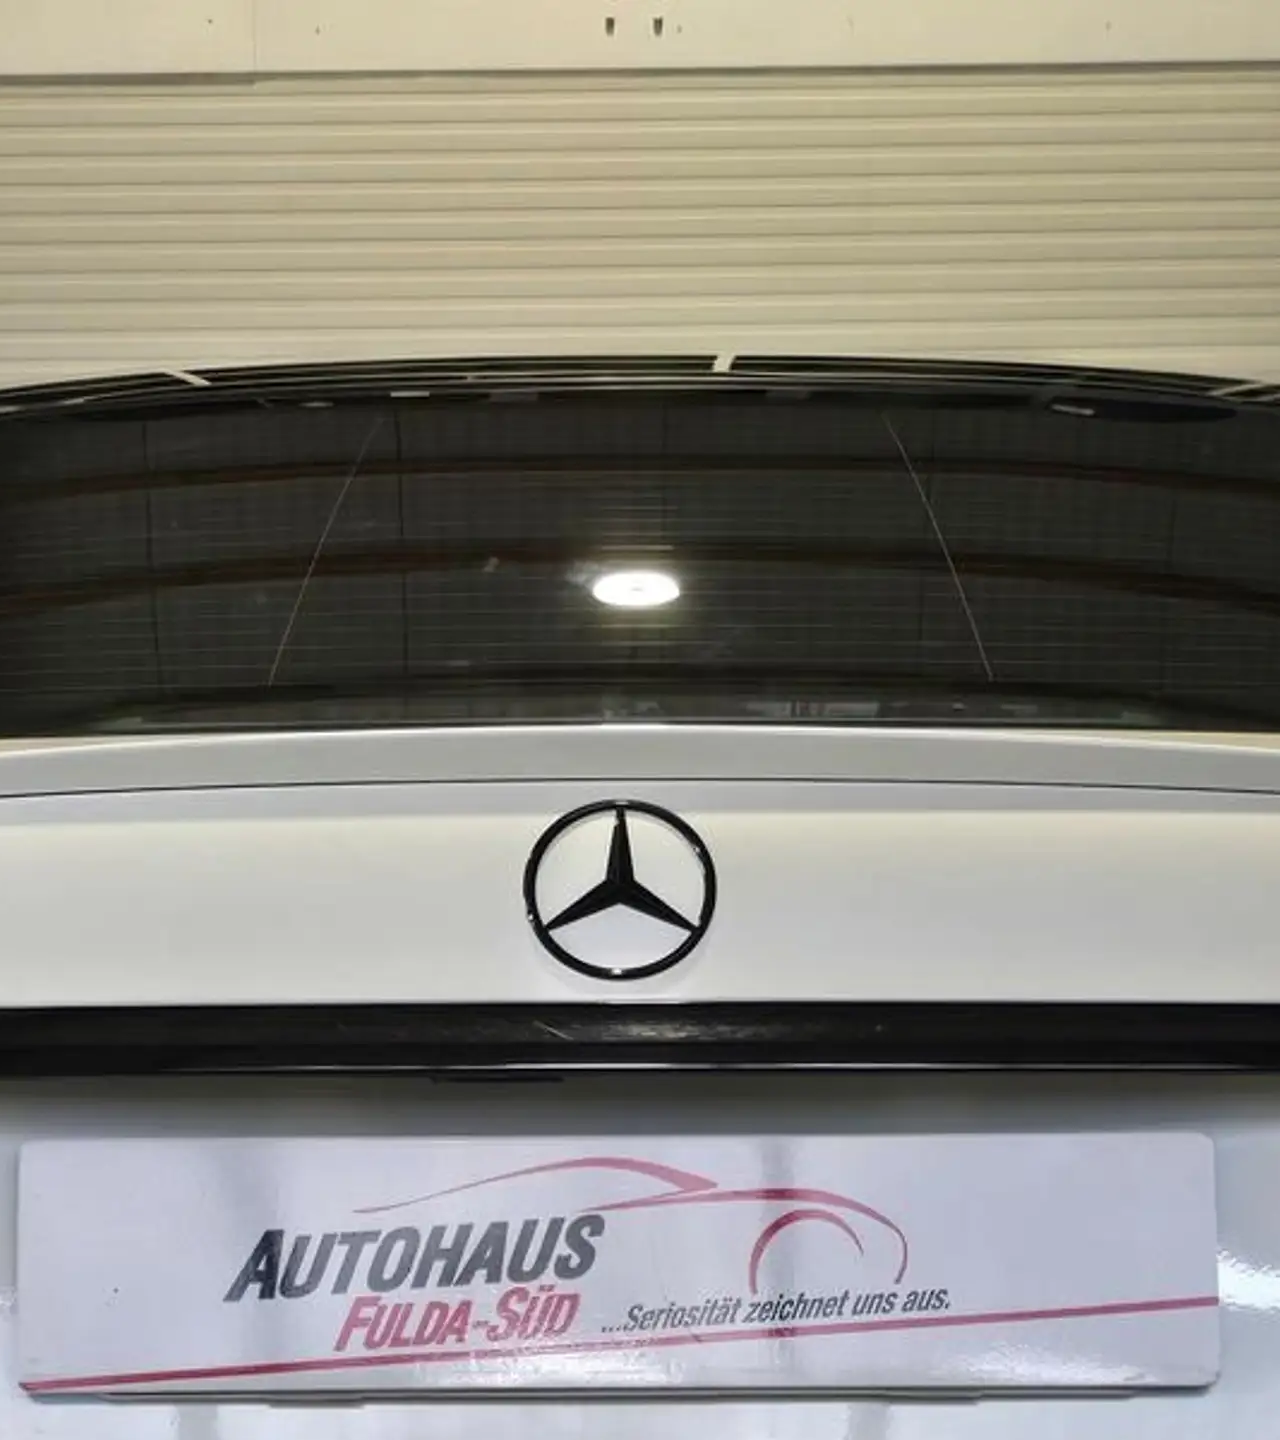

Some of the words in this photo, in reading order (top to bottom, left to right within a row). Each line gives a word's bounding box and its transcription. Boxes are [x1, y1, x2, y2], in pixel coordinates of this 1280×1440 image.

[223, 1213, 605, 1302] AUTOHAUS
[333, 1284, 581, 1352] FULDA-SÜD
[601, 1296, 742, 1333] ...Seriosität
[742, 1289, 850, 1323] zeichnet
[851, 1295, 897, 1317] uns
[900, 1288, 952, 1313] aus.
